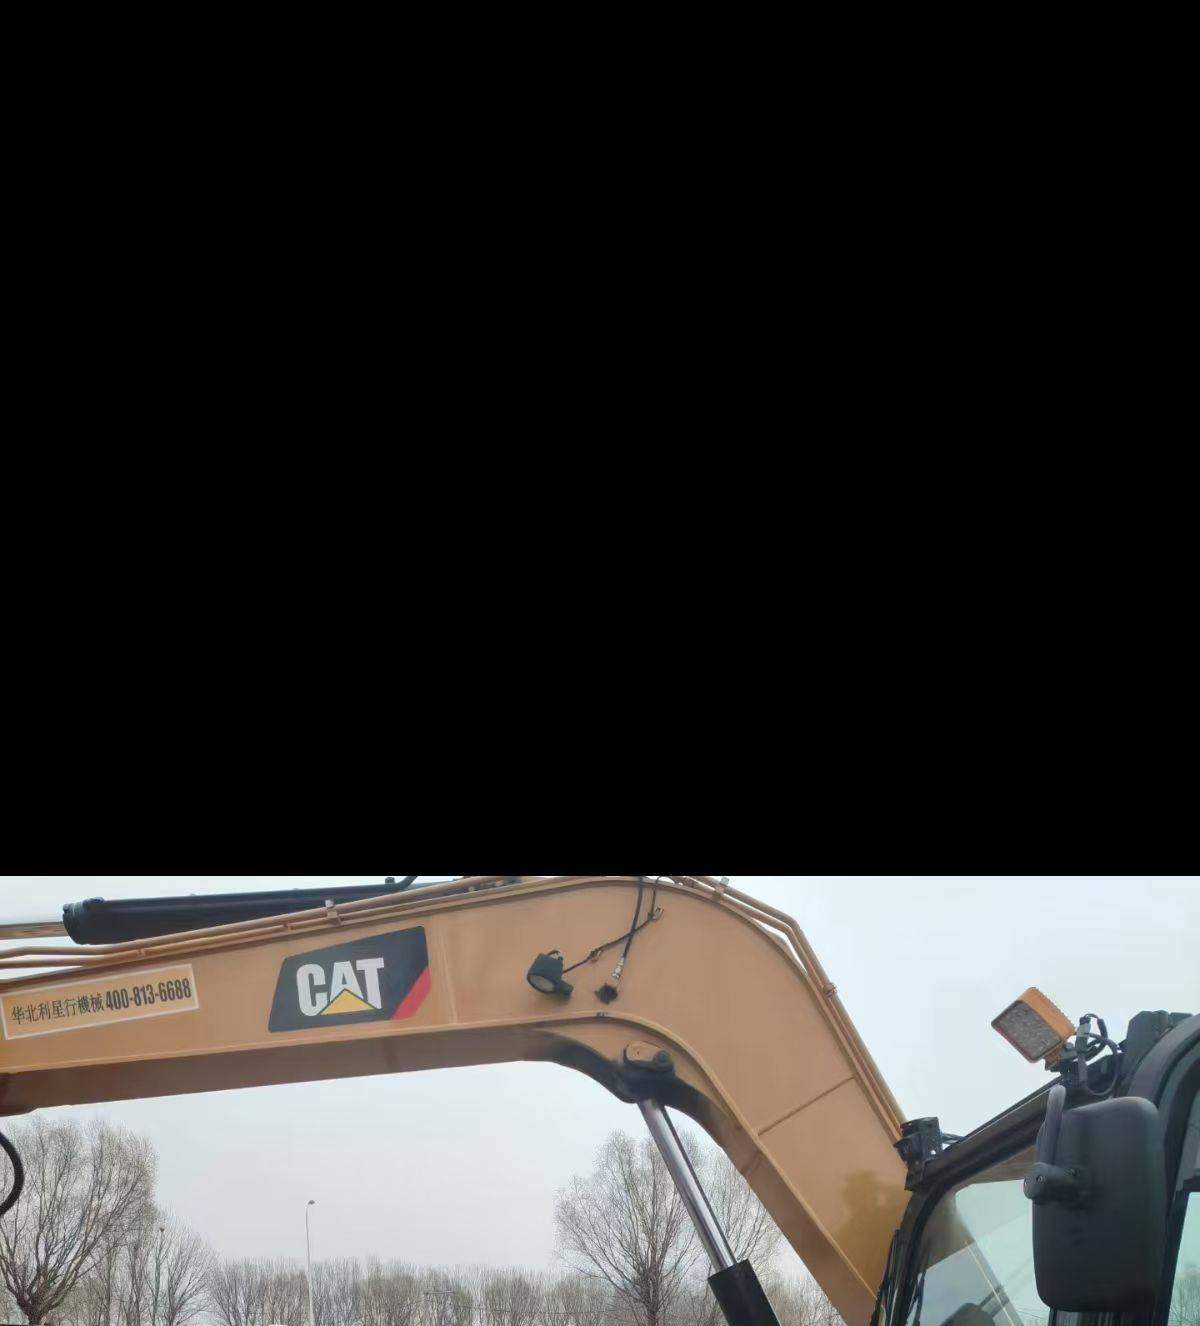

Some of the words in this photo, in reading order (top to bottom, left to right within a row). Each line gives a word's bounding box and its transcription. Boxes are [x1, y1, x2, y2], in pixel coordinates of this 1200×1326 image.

[12, 994, 105, 1025] 华北利星行機械
[105, 978, 192, 1011] 400-813-6688
[296, 957, 384, 1016] CAT
